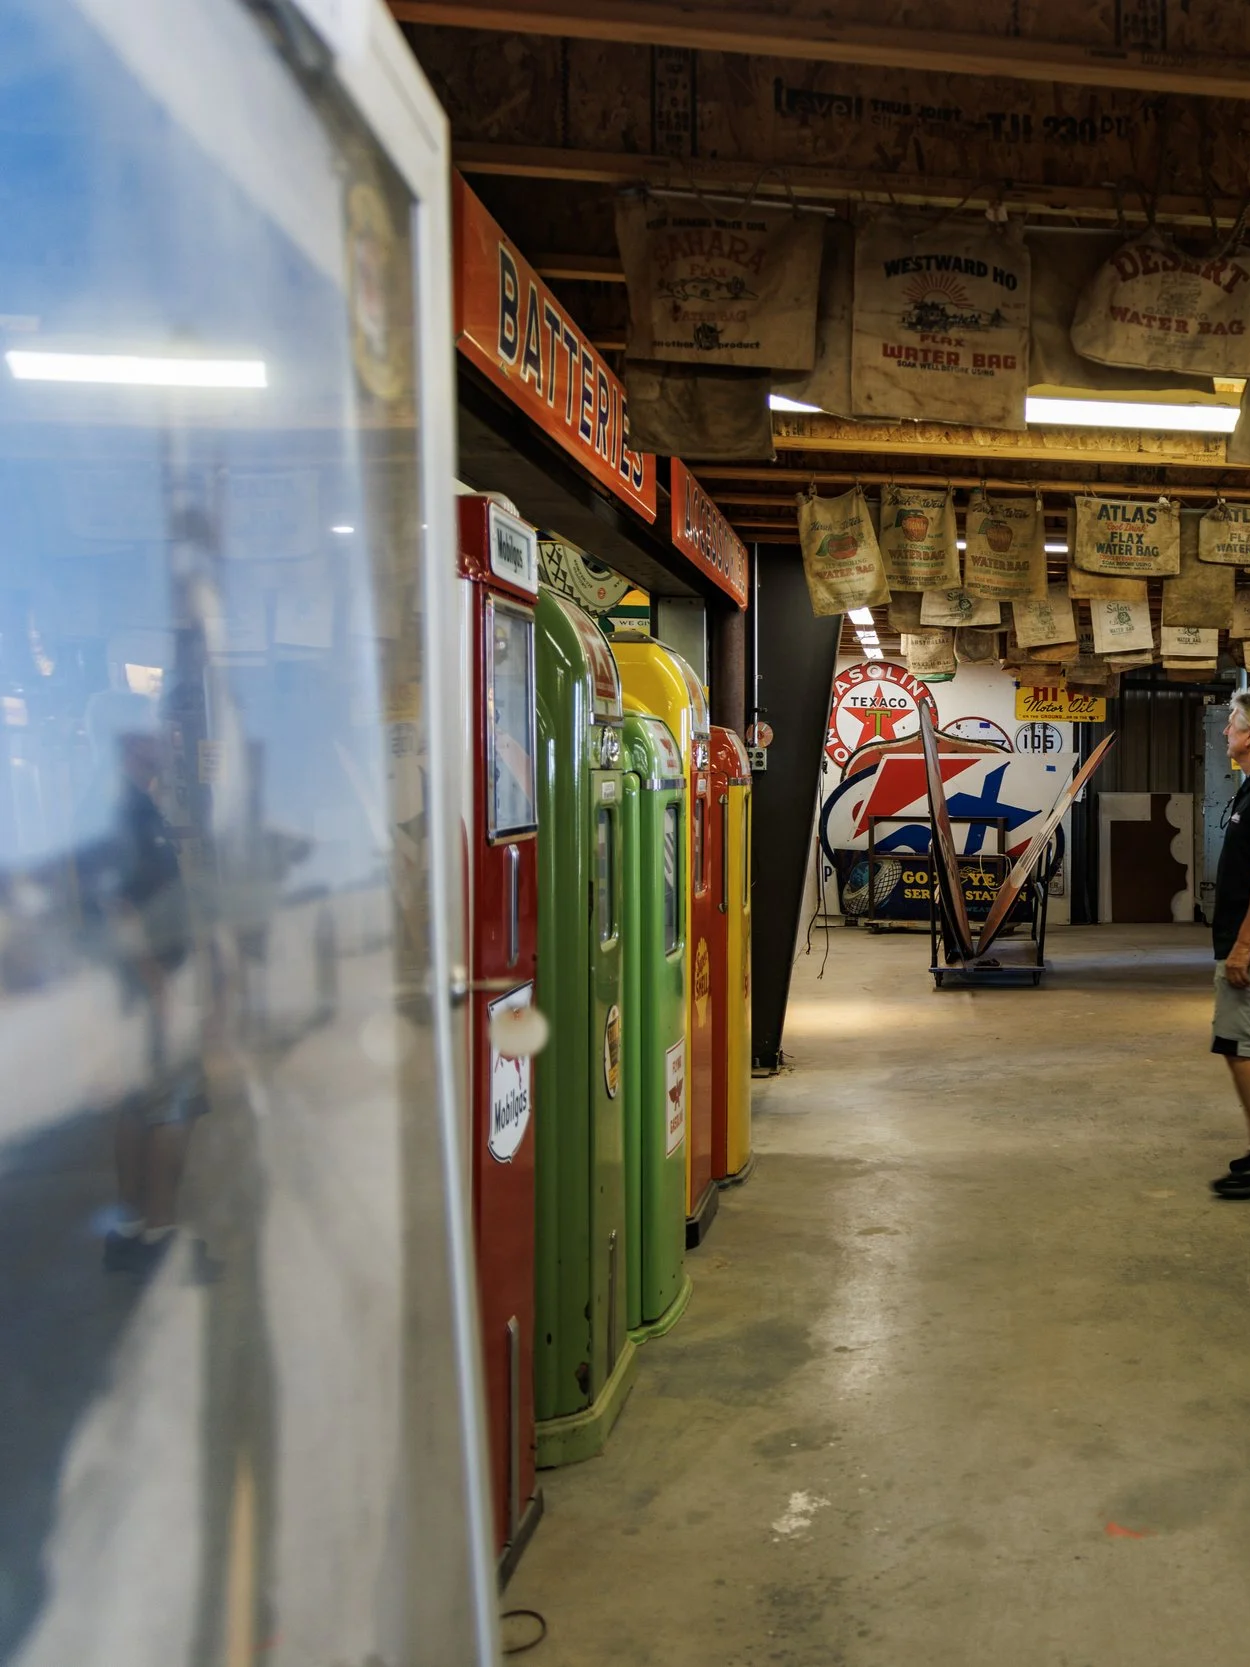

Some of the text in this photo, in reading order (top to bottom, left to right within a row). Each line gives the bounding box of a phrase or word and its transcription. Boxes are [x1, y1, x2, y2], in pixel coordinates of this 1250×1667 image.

[1042, 116, 1098, 143] 230
[653, 230, 767, 275] SAHARA
[689, 263, 726, 278] FLAX
[882, 254, 1018, 291] WESTWARD HO
[1109, 305, 1247, 336] WATER BAG
[919, 333, 965, 348] FLAX
[881, 342, 1017, 370] WATER BAG
[497, 240, 644, 493] BATTERIES
[896, 359, 917, 368] SOAK
[919, 362, 941, 372] WELL
[971, 368, 995, 377] USING
[1096, 504, 1158, 525] ATLAS
[1110, 531, 1145, 545] FLAX
[496, 527, 524, 573] Mobilgas
[888, 549, 924, 561] WATER
[1095, 541, 1160, 557] WATER BAG
[815, 567, 854, 580] WATER
[855, 563, 875, 576] BAG
[970, 554, 1030, 571] WATER BAG
[850, 696, 908, 709] TEXACO
[1023, 695, 1095, 713] Motor Oil
[1024, 734, 1054, 749] 105
[696, 972, 709, 1001] SHELL
[494, 1089, 528, 1135] Mobilgas
